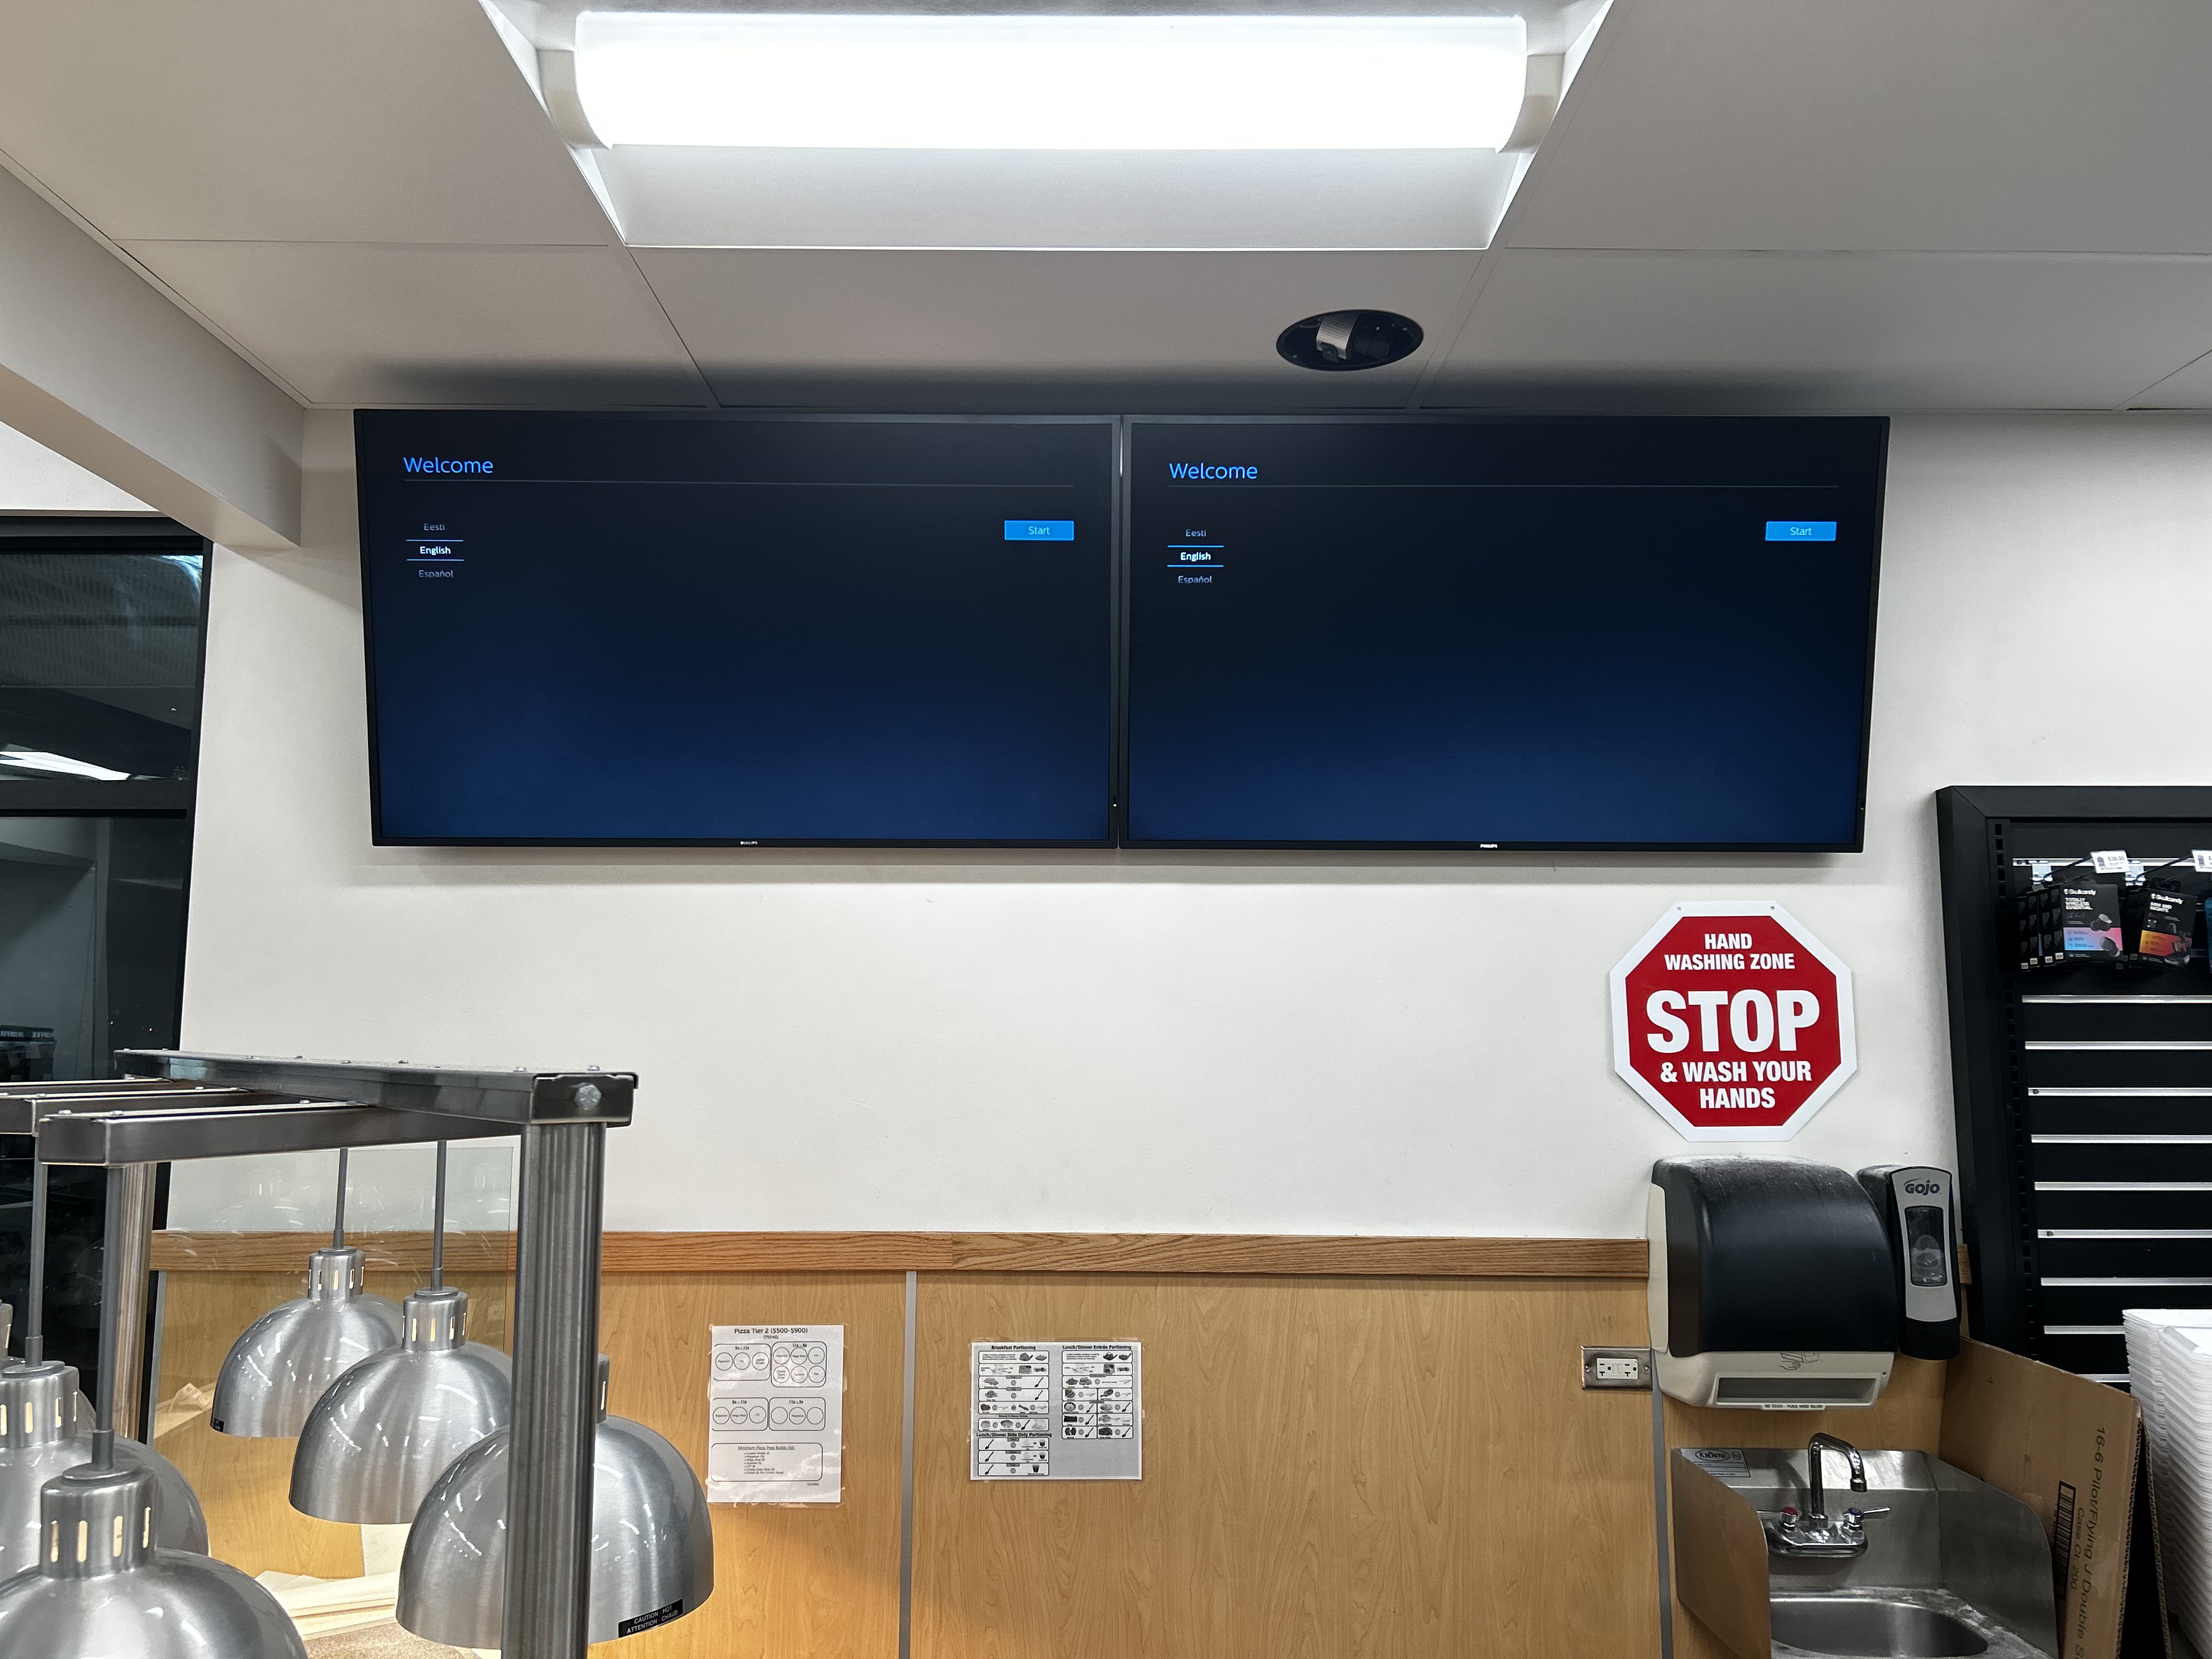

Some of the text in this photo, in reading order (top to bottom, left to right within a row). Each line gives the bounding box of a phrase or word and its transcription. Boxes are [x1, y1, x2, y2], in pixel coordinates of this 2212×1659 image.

[403, 457, 493, 473] Welcome
[1169, 463, 1258, 479] Welcome
[424, 523, 445, 532] Eesti
[1028, 526, 1050, 536] Start
[1186, 529, 1206, 538] Eesti
[1790, 527, 1813, 536] Start
[420, 546, 451, 556] English
[1180, 551, 1211, 562] English
[419, 569, 454, 579] Español
[1178, 575, 1212, 585] Español
[1705, 933, 1752, 950] HAND
[1664, 953, 1795, 970] WASHING ZONE
[1646, 989, 1820, 1053] STOP
[1660, 1060, 1812, 1083] & WASH YOUR
[1700, 1087, 1775, 1109] HANDS
[1905, 1180, 1940, 1195] GOJO
[2095, 1427, 2106, 1463] 16-6
[2085, 1467, 2102, 1559] Pilot/Flying
[2076, 1508, 2085, 1539] Case
[2085, 1564, 2092, 1576] J
[634, 1611, 658, 1624] CAUTION
[662, 1605, 673, 1613] HOT
[2078, 1578, 2091, 1639] Double
[627, 1619, 658, 1634] ATTENTION
[662, 1610, 678, 1621] CHAUD
